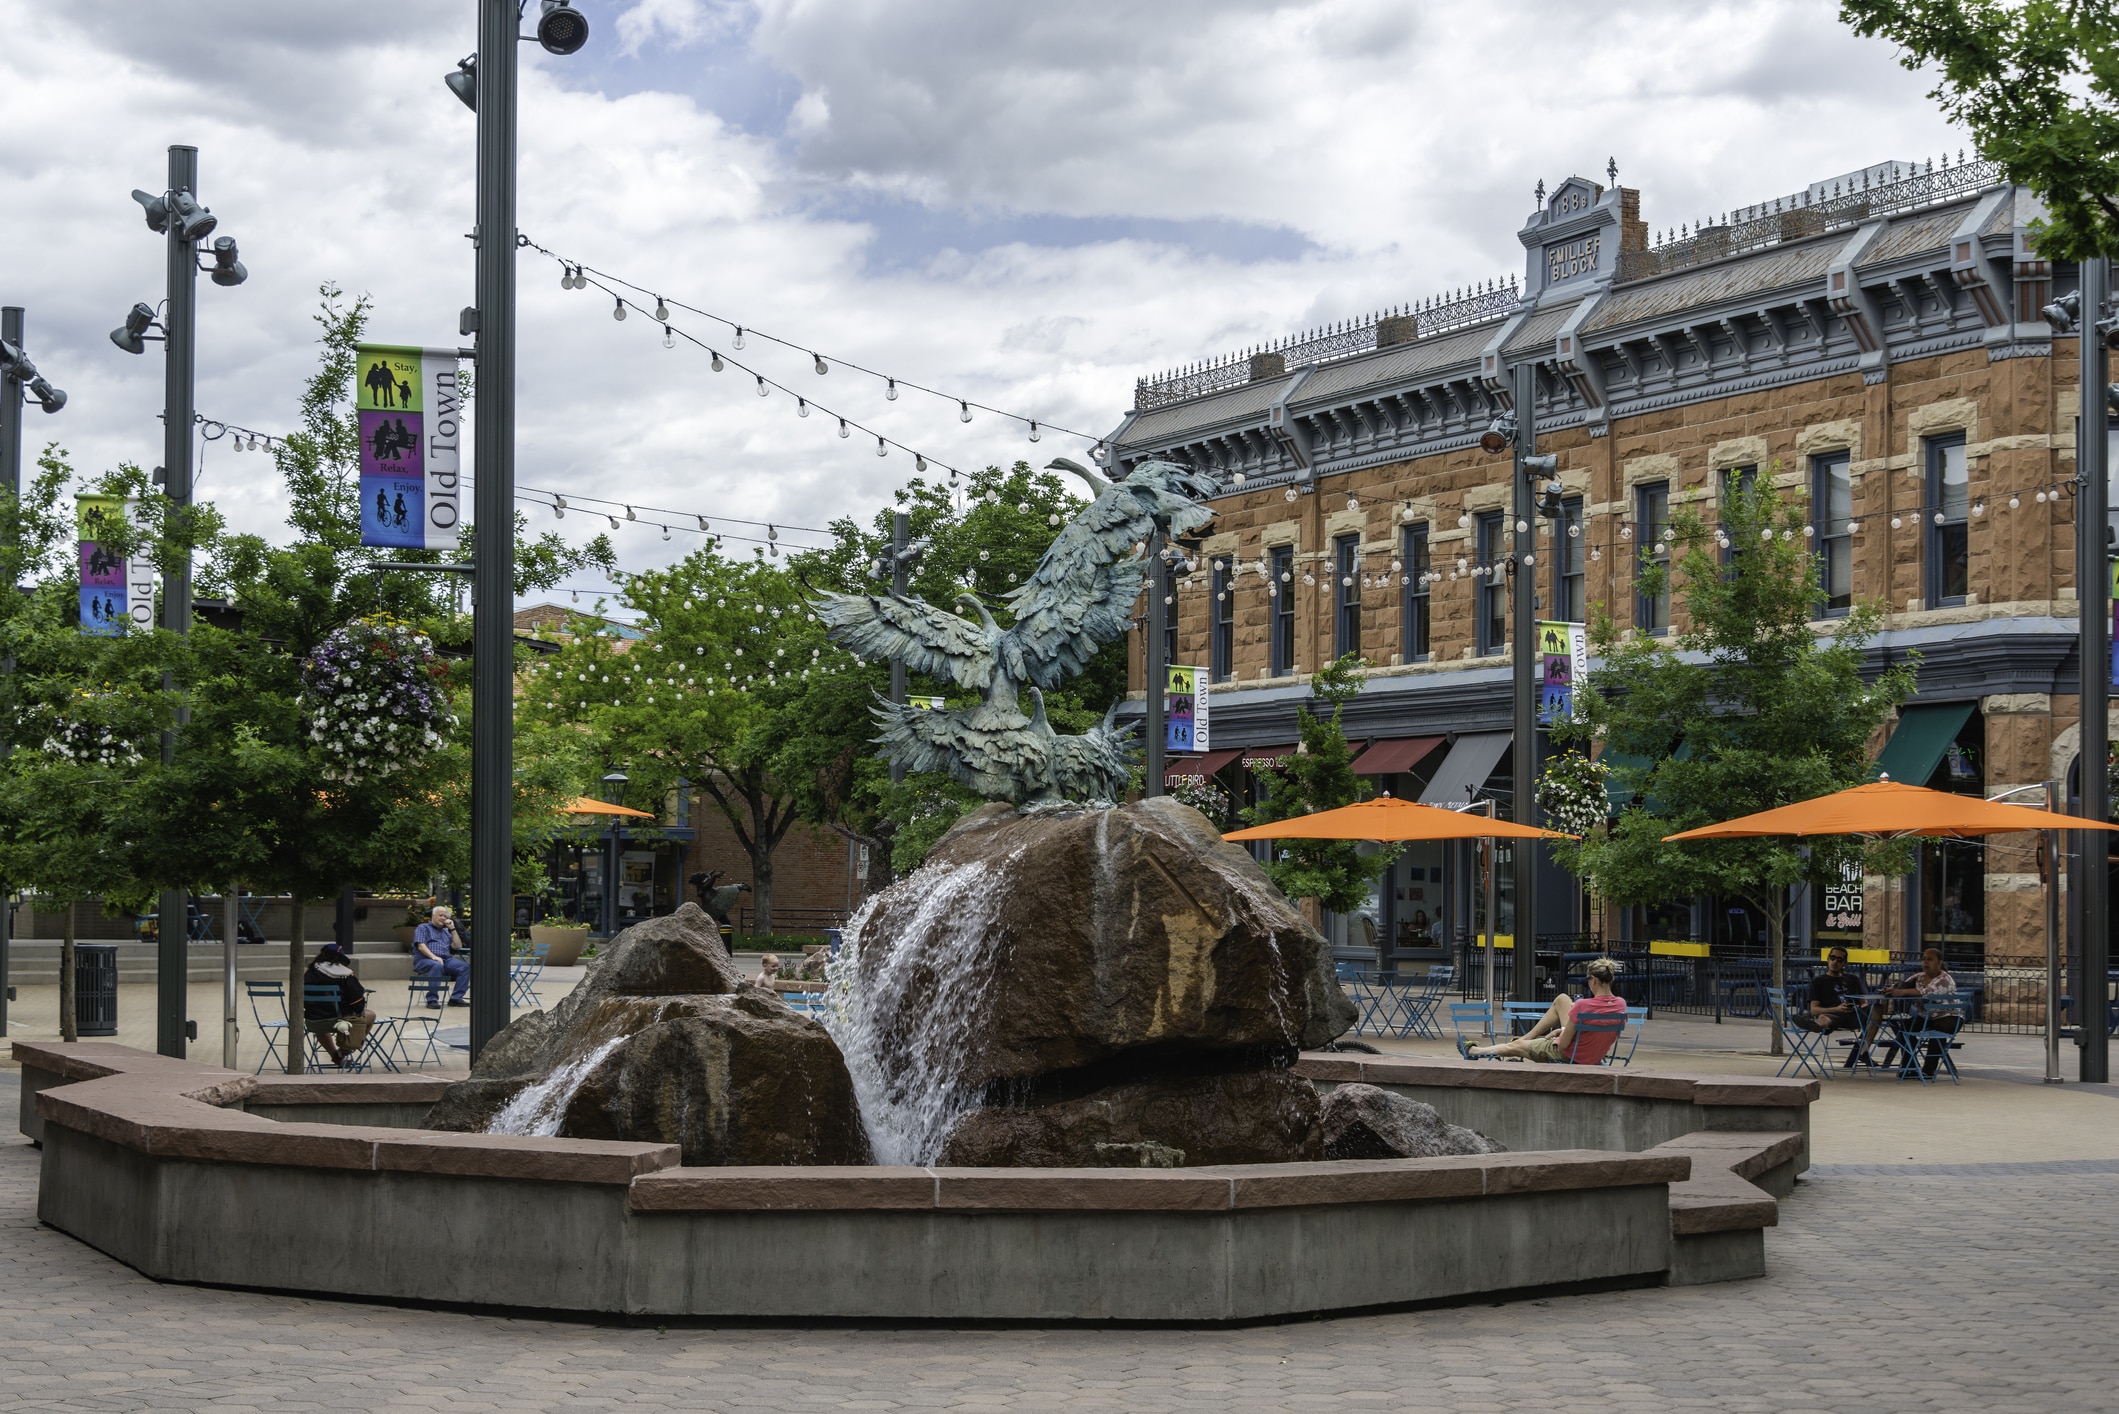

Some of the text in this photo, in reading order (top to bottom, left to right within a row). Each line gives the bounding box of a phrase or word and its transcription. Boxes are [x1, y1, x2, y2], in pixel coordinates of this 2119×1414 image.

[1556, 192, 1587, 216] 1888
[1553, 254, 1597, 281] BLOCK
[394, 362, 418, 373] Stay,
[430, 371, 458, 529] Old Town
[380, 463, 409, 474] Relax,
[393, 481, 423, 493] Enjoy.
[131, 582, 152, 623] Old
[1196, 677, 1207, 743] Old Town
[1187, 774, 1205, 786] BIRD
[1825, 895, 1863, 911] BAR
[1825, 911, 1862, 928] & Grill
